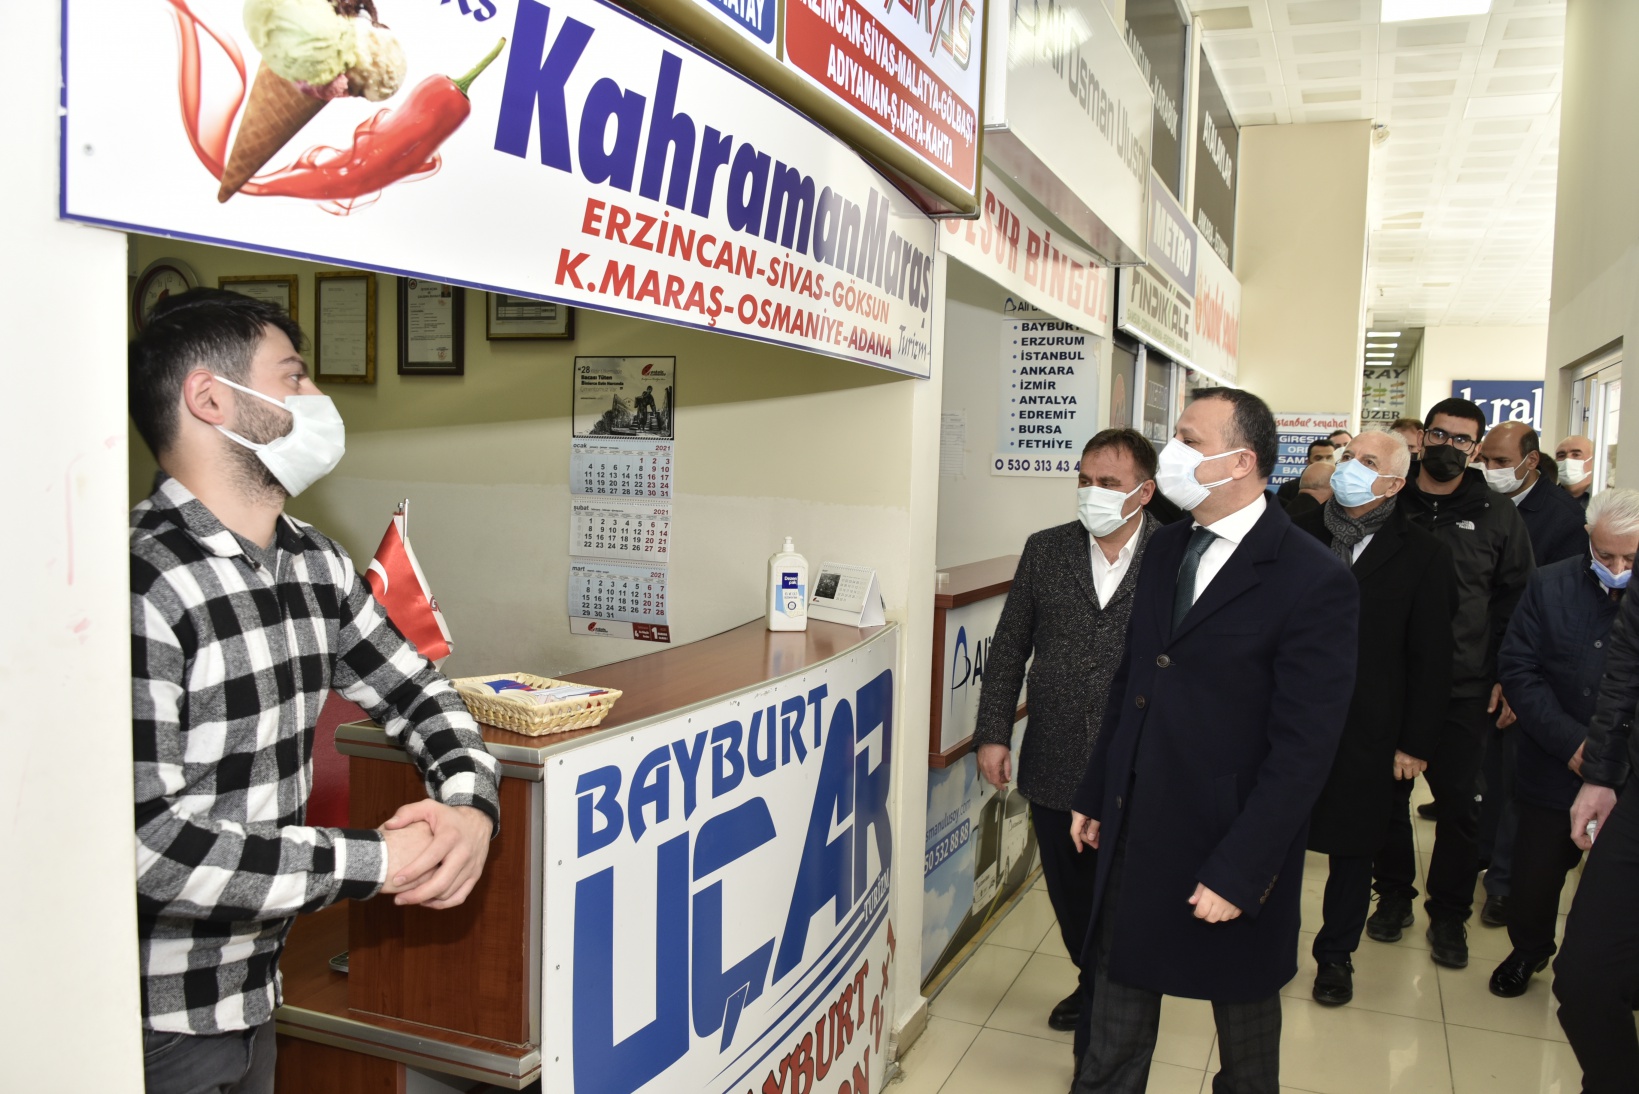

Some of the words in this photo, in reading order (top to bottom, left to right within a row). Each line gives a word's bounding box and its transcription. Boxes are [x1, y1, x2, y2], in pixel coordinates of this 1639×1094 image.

[827, 44, 953, 168] ADIYAMAN-Ş.URFA-KAHTA
[1068, 27, 1114, 147] Osman
[1116, 98, 1149, 203] Ulusoy
[494, 0, 932, 328] KahramanMaraş
[1153, 200, 1191, 277] METRO
[581, 197, 891, 325] ERZİNCAN-SİVAS-GÖKSUN
[1024, 225, 1108, 324] BİNGÖL
[554, 248, 892, 360] K.MARAŞ-OSMANİYE-ADANA
[898, 324, 928, 361] Turizm
[1020, 351, 1085, 361] İSTANBUL
[1021, 336, 1085, 346] ERZURUM
[1020, 366, 1074, 376] ANKARA
[1020, 380, 1056, 390] İZMİR
[1019, 396, 1077, 405] ANTALYA
[1019, 409, 1076, 420] EDREMİT
[1018, 425, 1062, 434] BURSA
[1313, 418, 1348, 430] seyahat
[1018, 439, 1073, 449] FETHİYE
[1007, 459, 1031, 470] 530
[1034, 460, 1052, 471] 313
[1056, 460, 1070, 472] 43
[575, 683, 828, 858] BAYBURT
[935, 839, 949, 866] 532
[949, 831, 959, 853] 88
[960, 822, 969, 845] 88
[572, 668, 894, 1094] UÇAR
